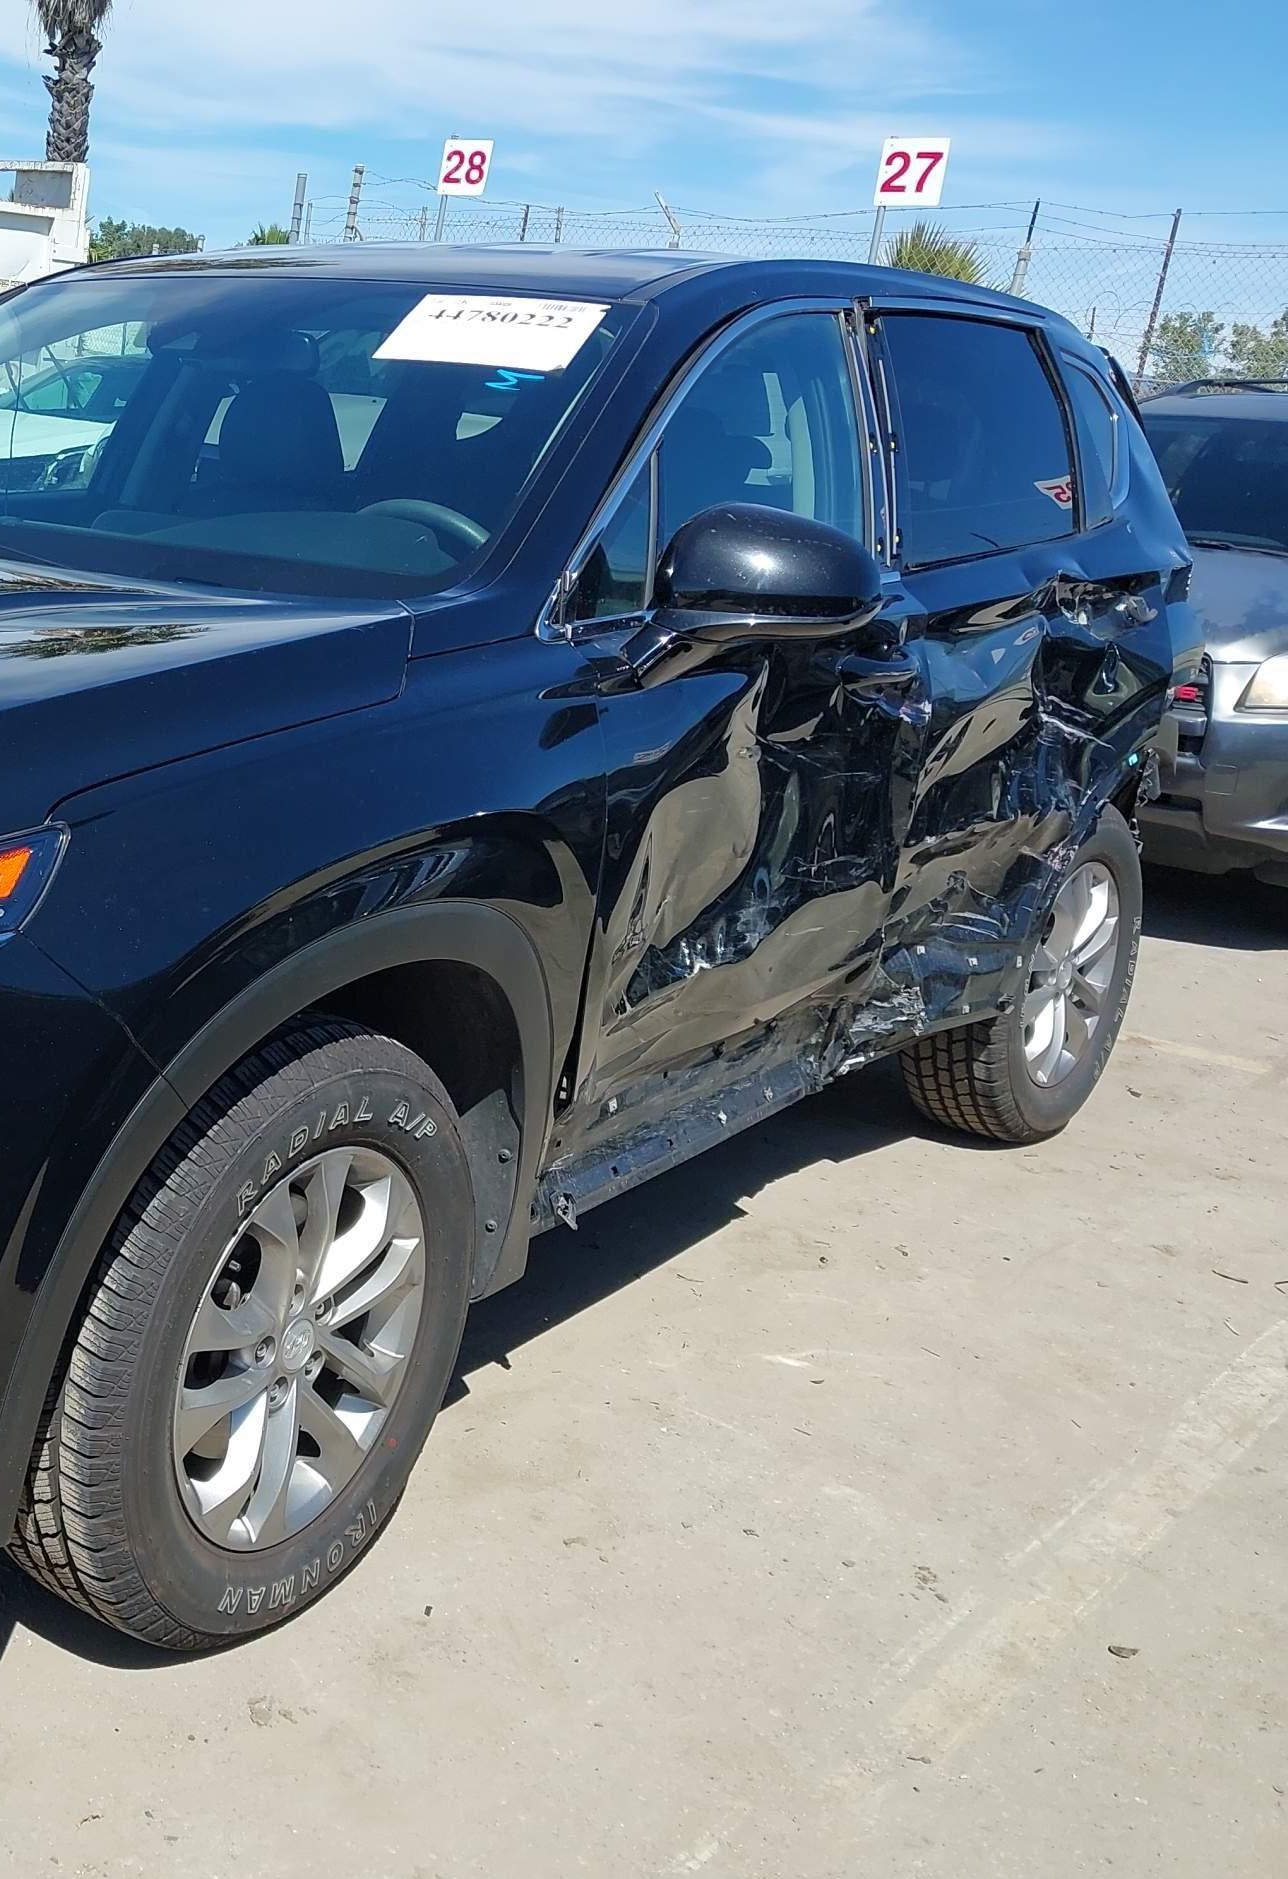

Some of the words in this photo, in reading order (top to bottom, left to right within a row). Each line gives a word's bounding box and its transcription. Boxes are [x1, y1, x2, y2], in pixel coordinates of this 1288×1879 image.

[443, 150, 487, 184] 28
[880, 150, 944, 193] 27
[428, 308, 573, 329] 44780222
[236, 1096, 373, 1217] RADIAL
[387, 1101, 438, 1139] A/P
[217, 1498, 377, 1615] IRONMAN
